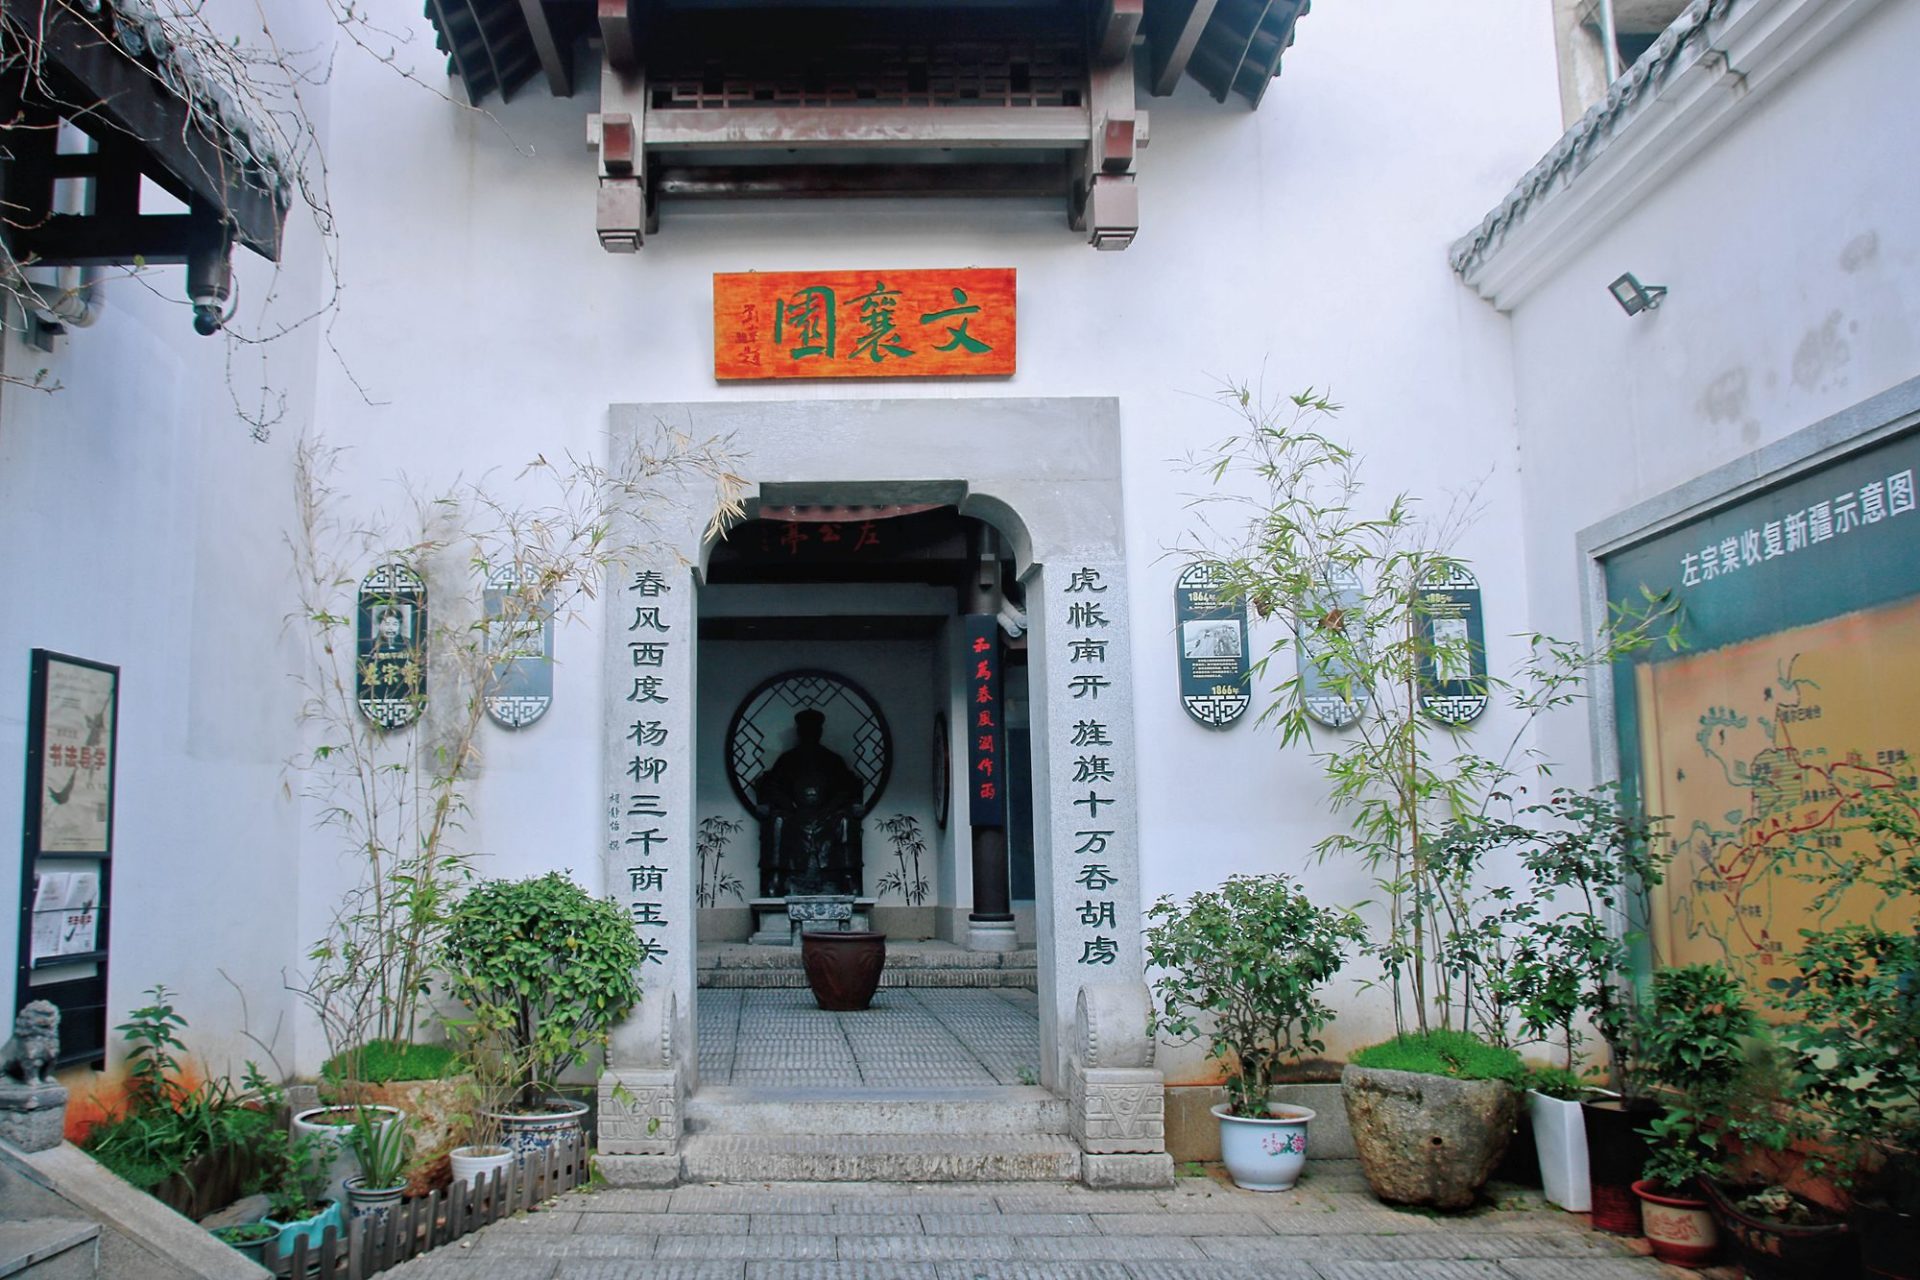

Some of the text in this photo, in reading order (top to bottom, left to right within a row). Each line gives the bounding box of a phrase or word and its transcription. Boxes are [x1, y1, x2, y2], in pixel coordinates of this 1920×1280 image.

[1681, 469, 1916, 587] 左宗棠收复新疆示意图
[626, 569, 671, 965] 春风西度杨柳三千荫玉关
[1064, 567, 1118, 966] 虎帐南开旌旗十万吞胡虏
